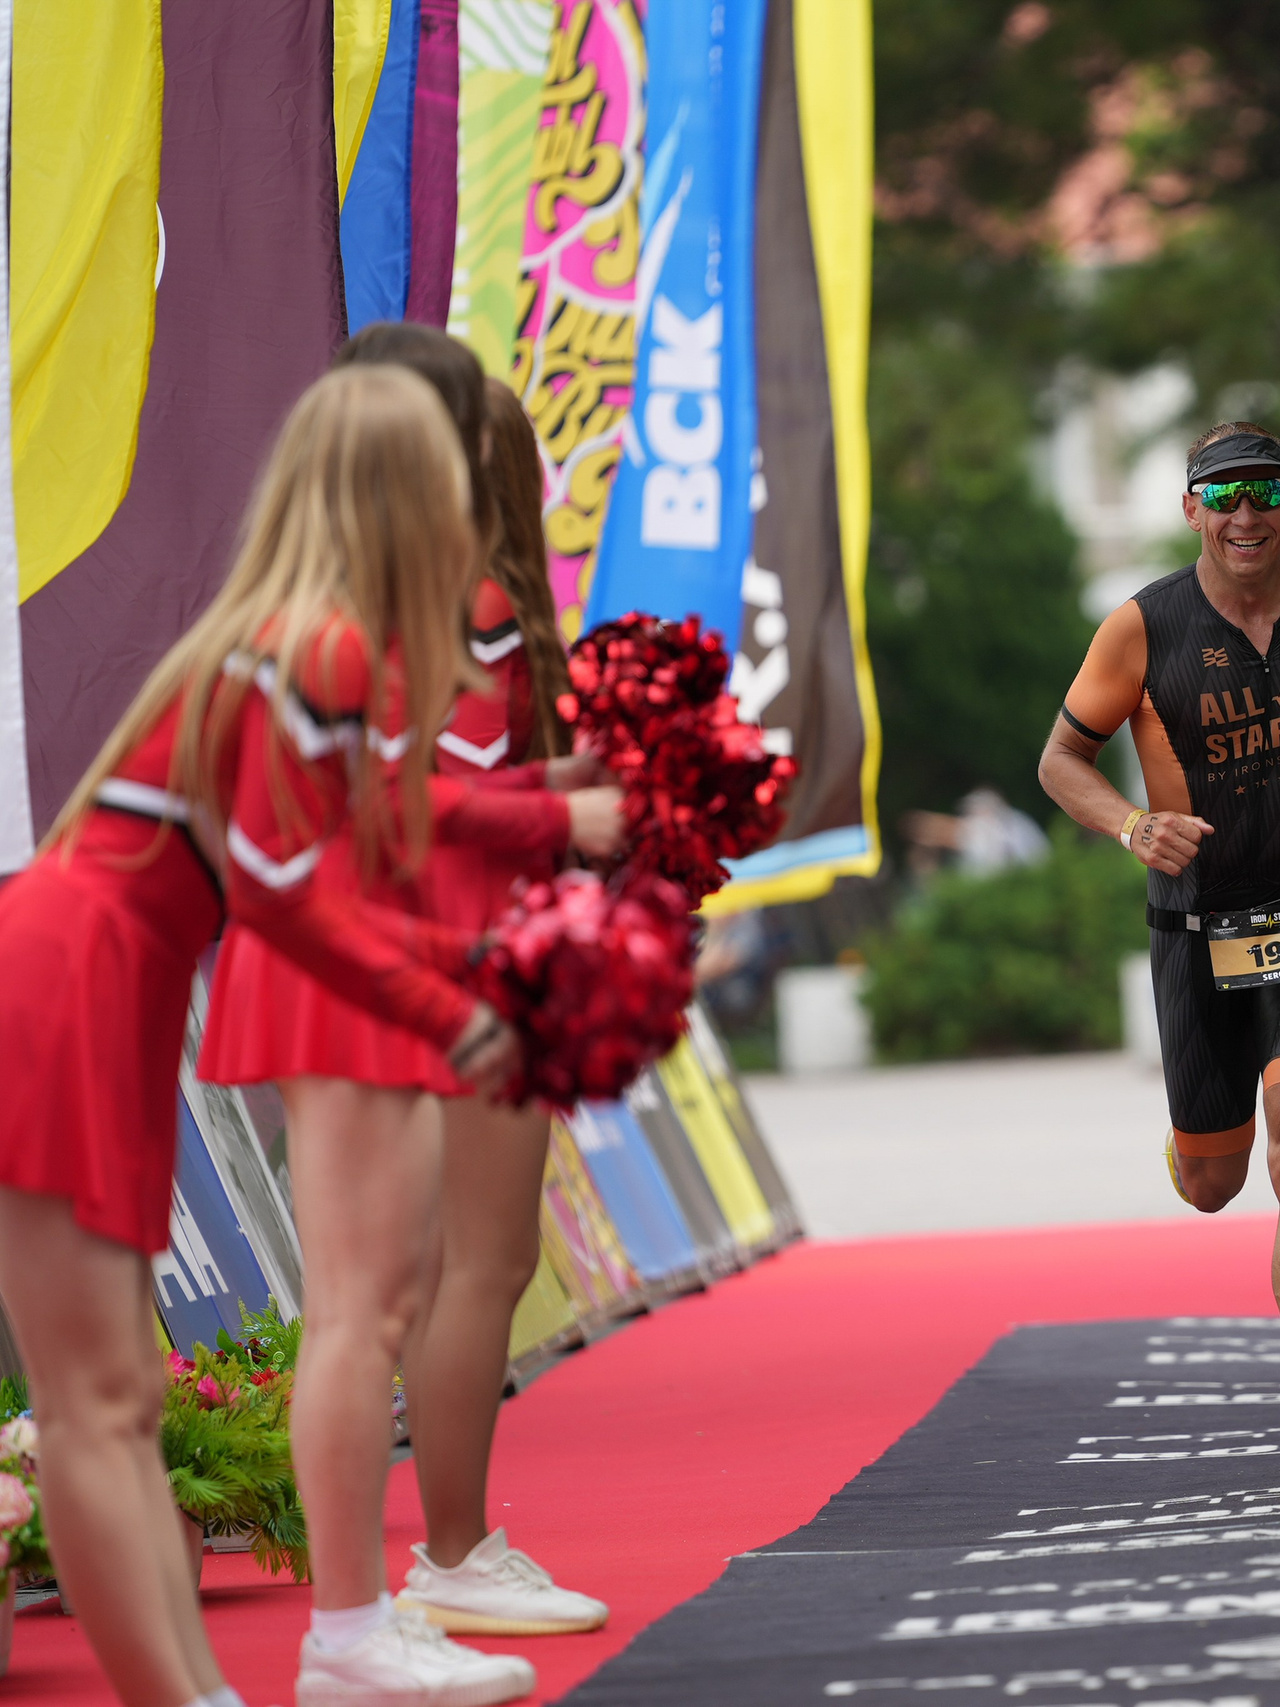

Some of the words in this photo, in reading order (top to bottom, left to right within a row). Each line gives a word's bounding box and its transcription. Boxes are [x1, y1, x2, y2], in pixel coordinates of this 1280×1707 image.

[1200, 686, 1265, 726] ALL
[1207, 771, 1226, 782] BY
[1250, 914, 1267, 924] IRON
